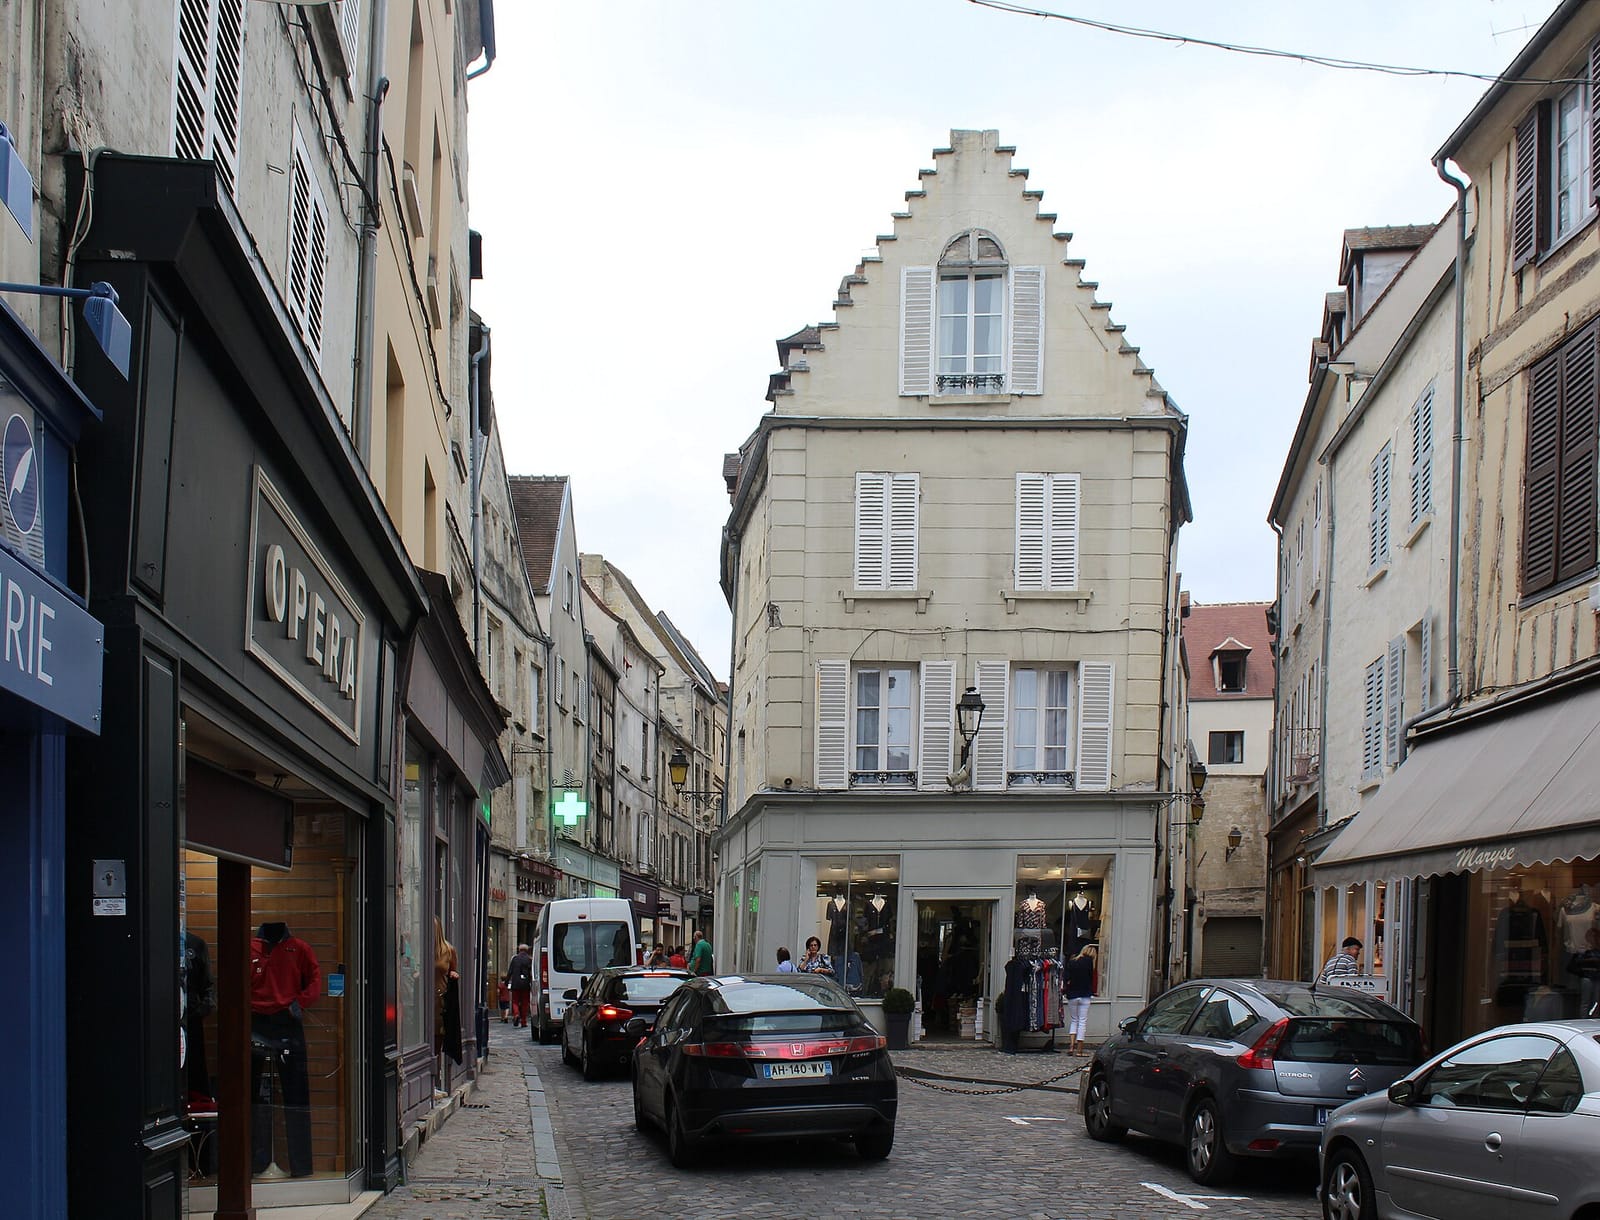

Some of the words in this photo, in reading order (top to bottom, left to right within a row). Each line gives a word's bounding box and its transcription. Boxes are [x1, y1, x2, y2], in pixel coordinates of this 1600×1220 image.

[0, 573, 56, 687] RIE
[265, 544, 355, 701] OPERA
[1456, 846, 1515, 869] Maryse
